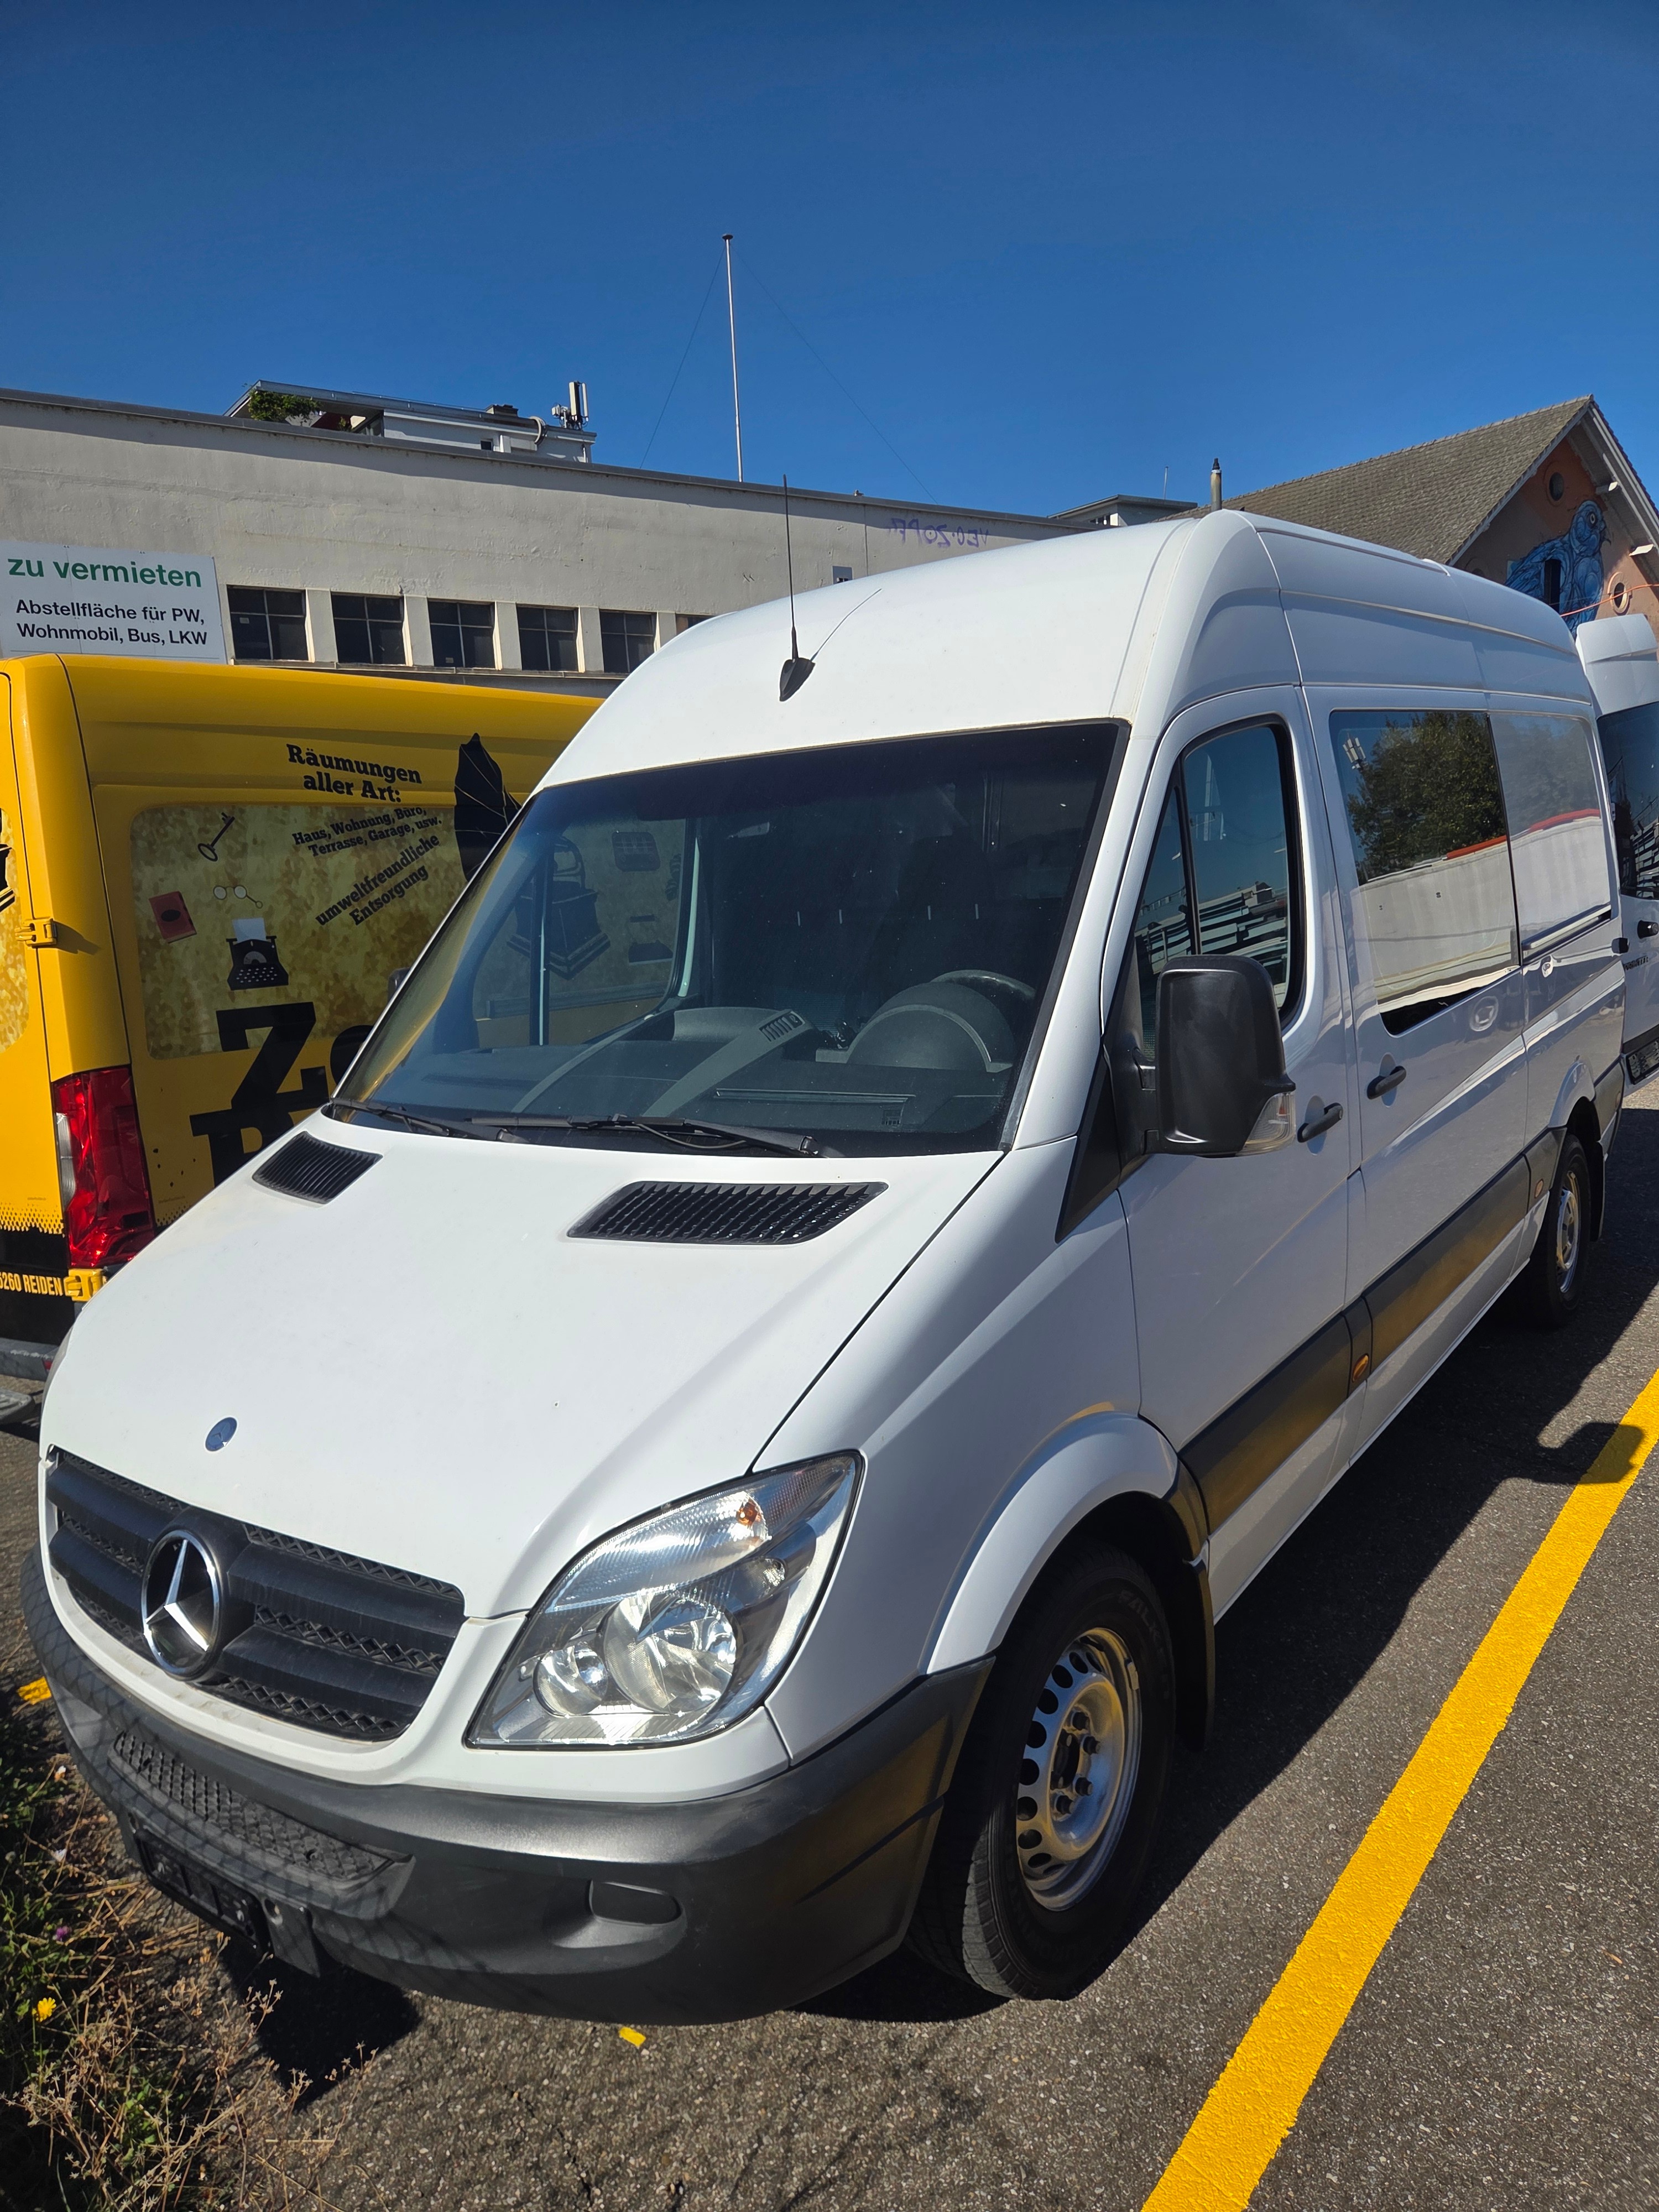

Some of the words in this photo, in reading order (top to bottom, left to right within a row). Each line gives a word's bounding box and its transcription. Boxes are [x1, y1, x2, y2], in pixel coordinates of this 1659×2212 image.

[8, 558, 44, 577] zu
[53, 560, 202, 587] vermieten
[16, 599, 137, 619] Abstellfläche
[142, 606, 166, 621] für
[172, 608, 204, 625] PW,
[17, 623, 124, 644] Wohnmobil,
[128, 628, 165, 646] Bus,
[169, 630, 207, 645] LKW
[286, 744, 422, 784] Räumungen
[304, 771, 354, 796] aller
[361, 780, 401, 802] Art:
[292, 828, 331, 845] Haus,
[330, 813, 395, 836] Wohnung,
[394, 806, 426, 820] Büro,
[308, 835, 367, 857] Terrasse,
[368, 822, 415, 842] Garage,
[415, 817, 442, 830] usw.
[315, 835, 440, 926] umweltfreundliche
[349, 865, 429, 926] Entsorgung
[22, 1274, 64, 1296] REIDEN
